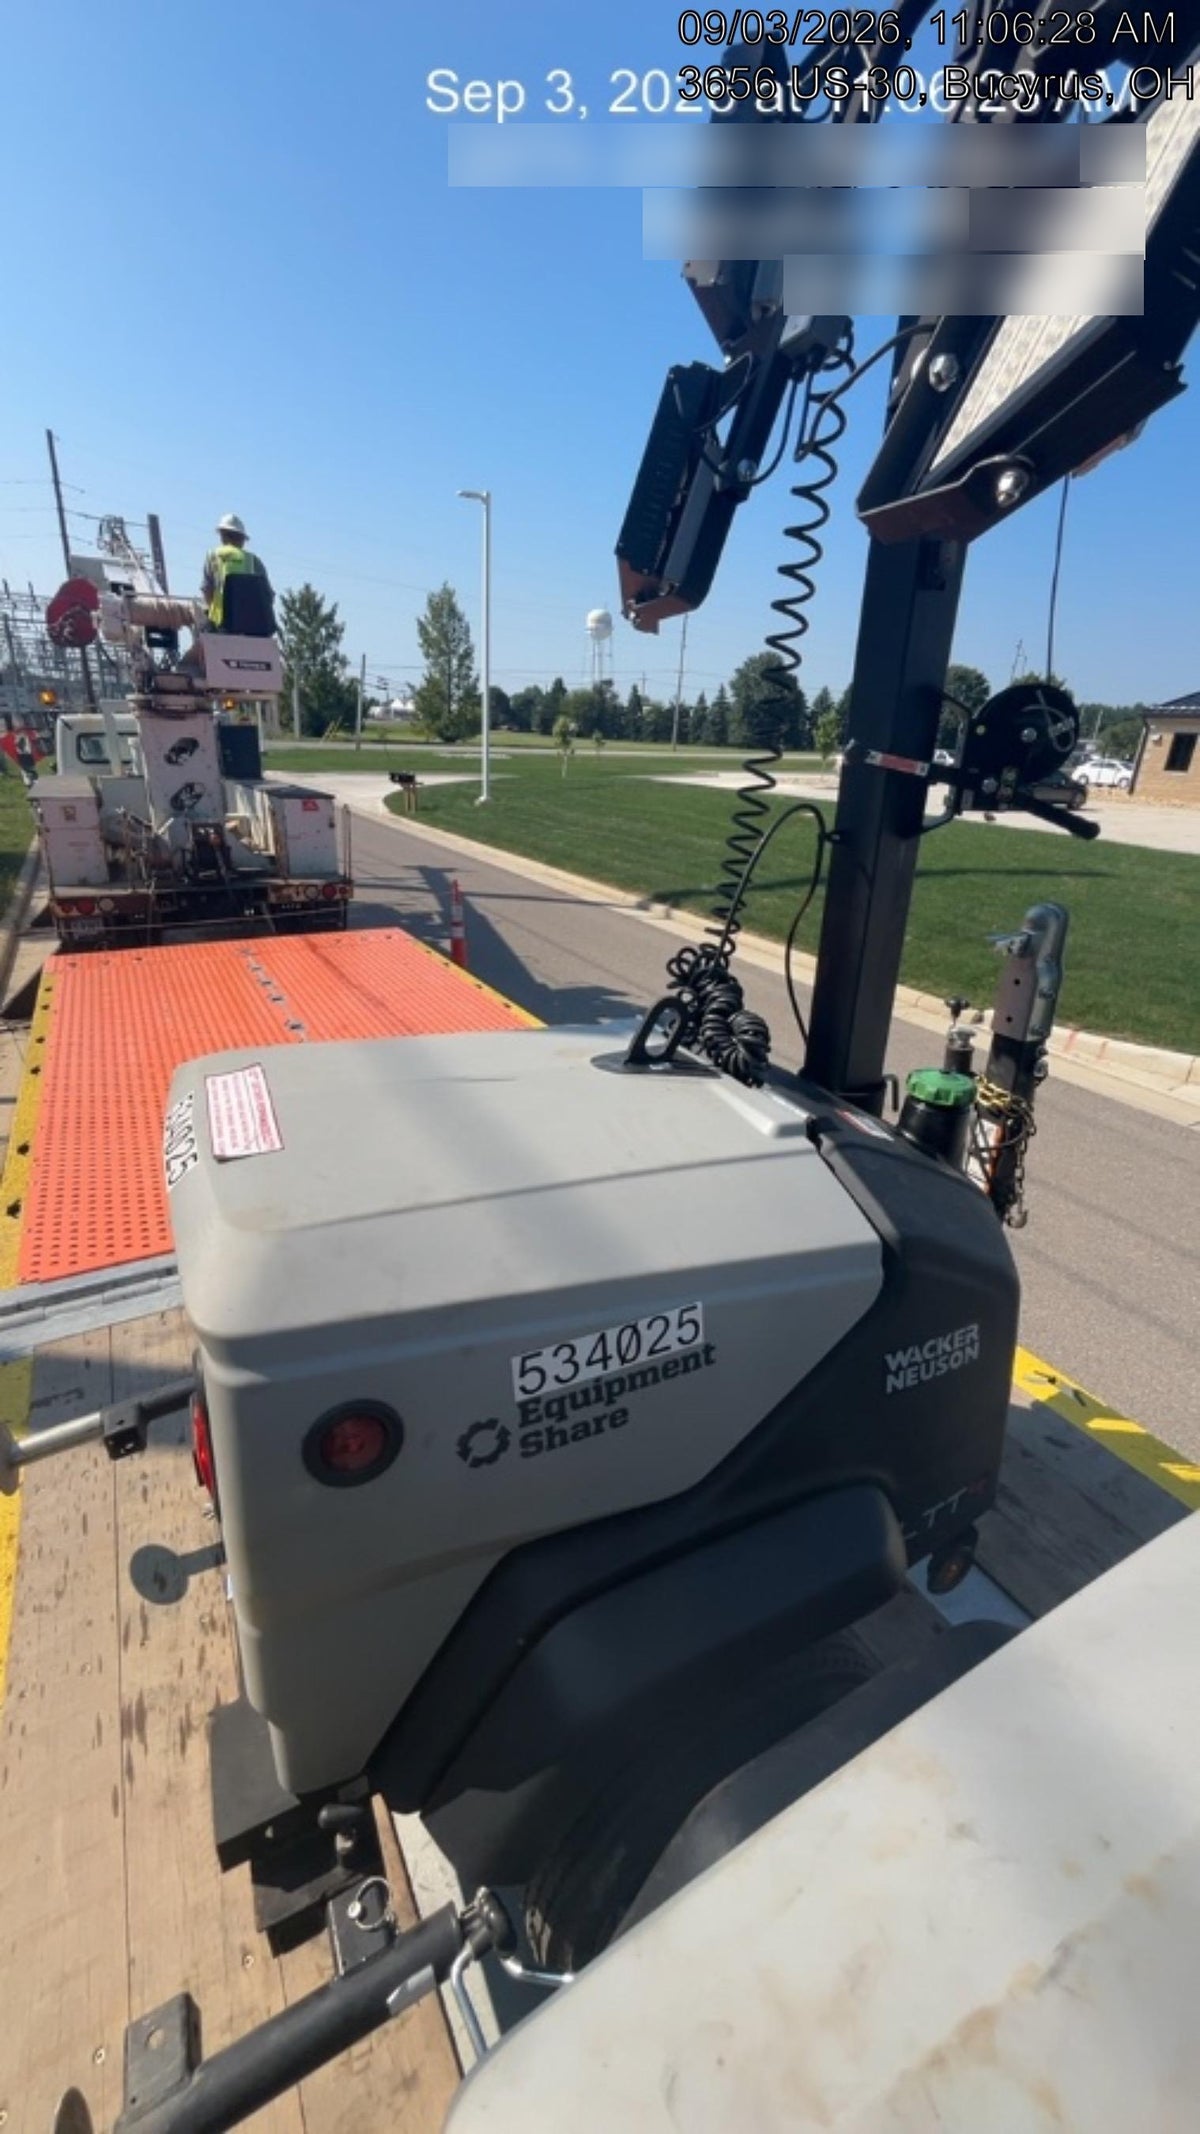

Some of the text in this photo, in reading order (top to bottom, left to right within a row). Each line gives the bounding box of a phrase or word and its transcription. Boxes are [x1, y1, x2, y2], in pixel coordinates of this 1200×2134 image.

[517, 1304, 701, 1396] 534025
[884, 1323, 980, 1373] WACKER
[885, 1341, 980, 1395] NEUSON
[516, 1343, 717, 1429] Equipment
[518, 1406, 631, 1459] Share
